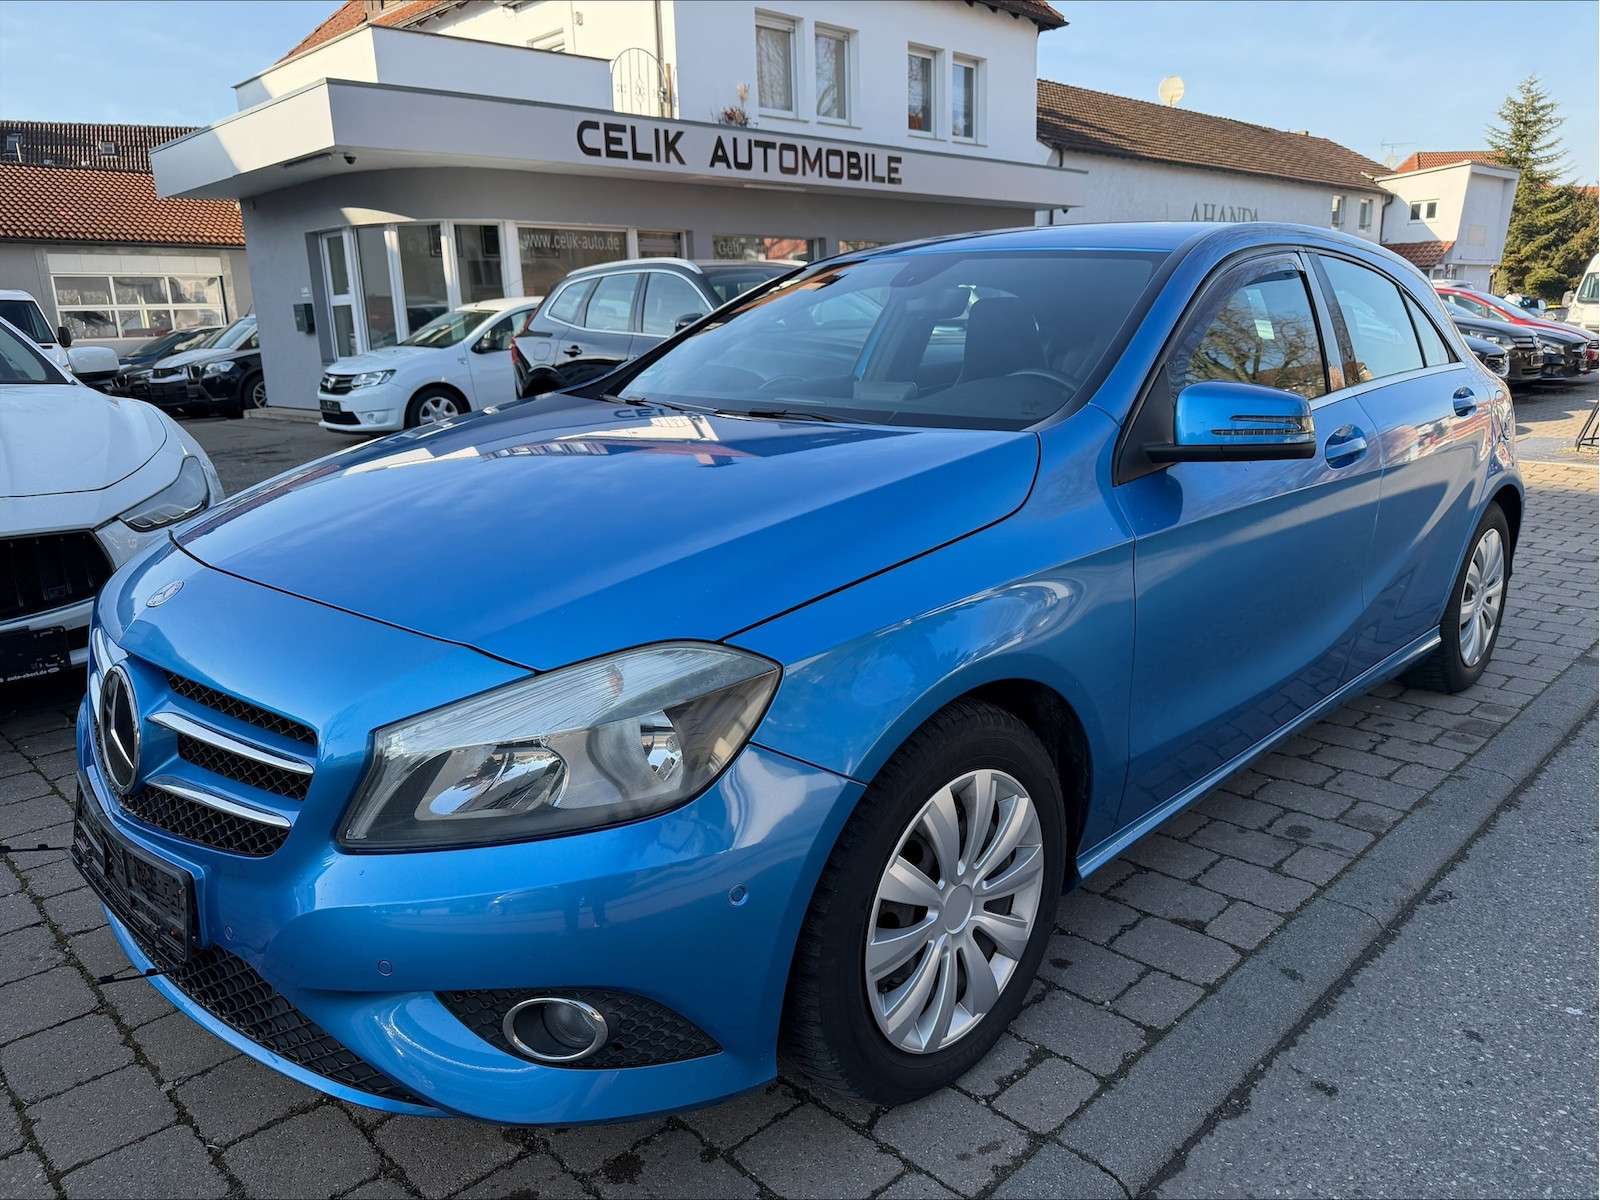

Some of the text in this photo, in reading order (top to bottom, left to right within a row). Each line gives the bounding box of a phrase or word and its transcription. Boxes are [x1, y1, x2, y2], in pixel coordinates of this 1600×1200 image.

[577, 120, 903, 185] CELIK AUTOMOBILE
[521, 231, 620, 250] www.celik-auto.de
